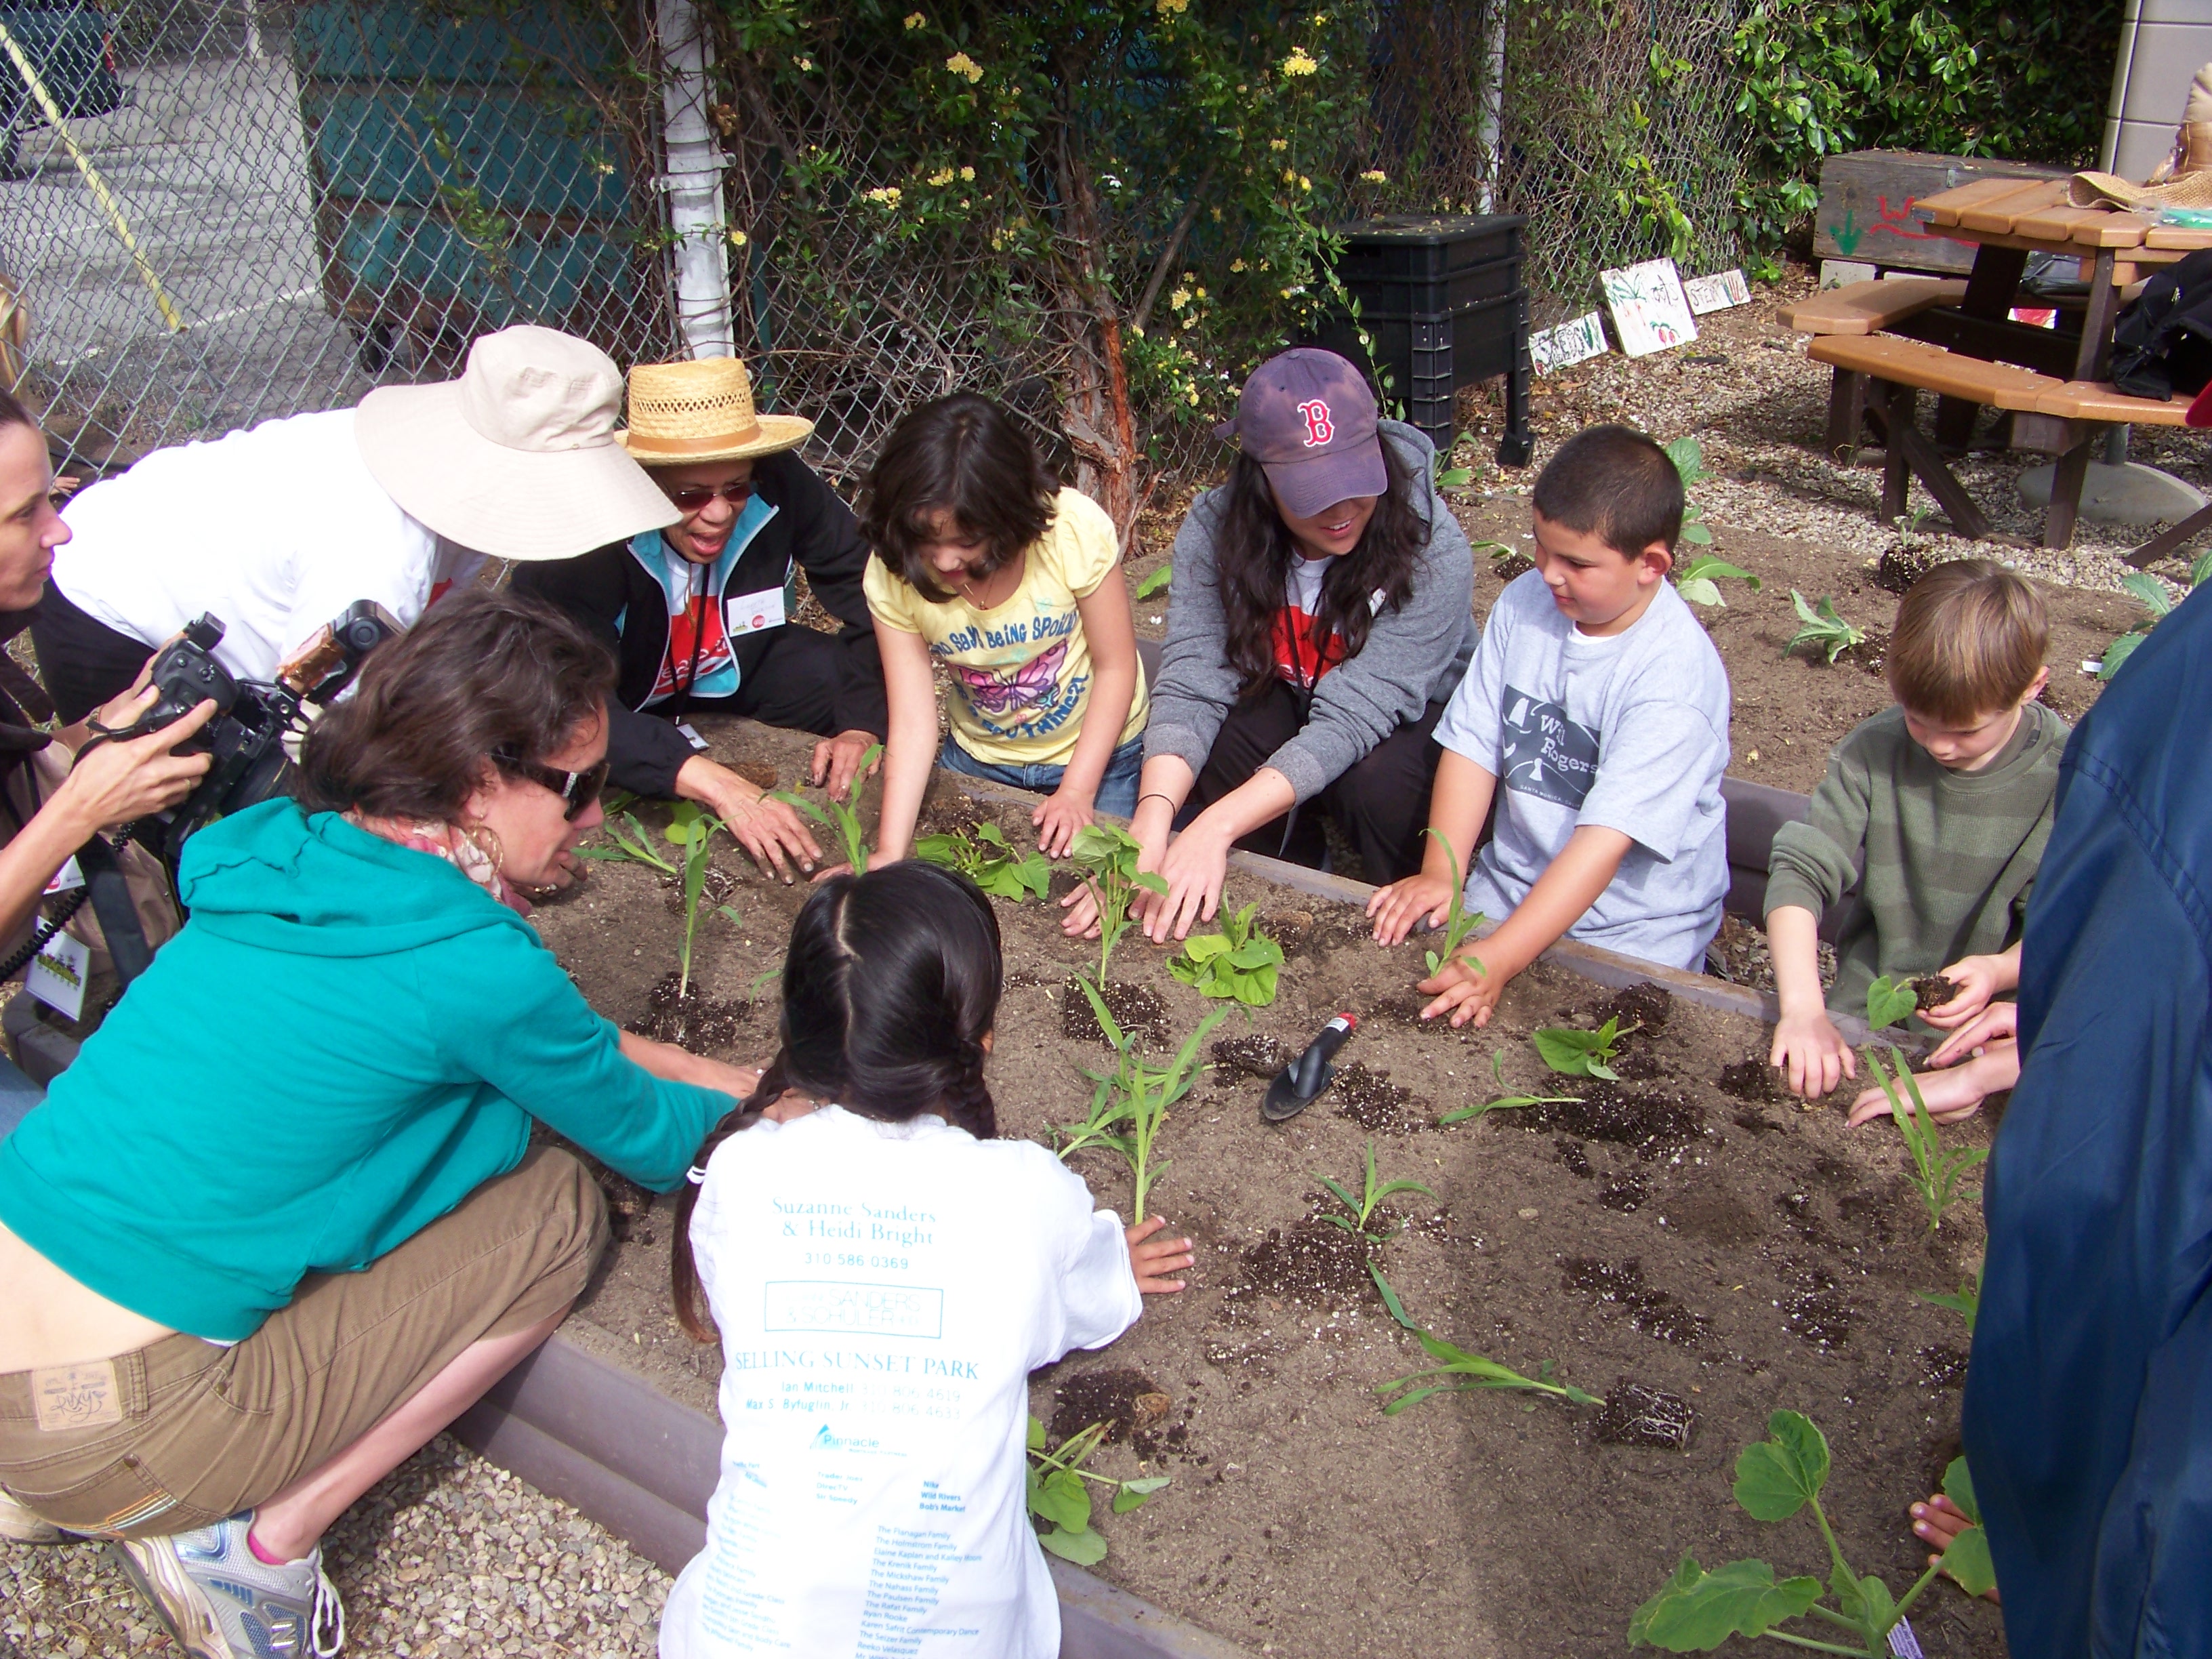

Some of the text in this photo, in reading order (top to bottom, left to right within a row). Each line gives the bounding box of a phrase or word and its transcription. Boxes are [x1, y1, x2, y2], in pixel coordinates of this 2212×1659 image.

[1297, 398, 1335, 447] B
[1540, 737, 1598, 774] Rogers
[1519, 784, 1538, 794] SANTA
[773, 1197, 936, 1223] Suzanne Sanders
[783, 1220, 933, 1248] & Heidi Bright
[805, 1252, 909, 1269] 310 586 0369
[829, 1288, 921, 1312] SANDERS
[800, 1306, 895, 1327] SCHULER
[735, 1350, 979, 1380] SELLING SUNSET PARK
[781, 1381, 798, 1393] Ian
[804, 1381, 854, 1394] Mitchell
[893, 1385, 920, 1399] 806
[926, 1388, 961, 1402] 4619
[745, 1399, 763, 1410] Max
[893, 1403, 919, 1416] 806
[824, 1435, 880, 1448] Pinnacle
[817, 1471, 842, 1479] Trader
[923, 1480, 939, 1489] Nike
[829, 1494, 858, 1506] Speedy
[921, 1491, 961, 1501] Wild Rivers
[919, 1502, 966, 1513] Bob's Market
[878, 1525, 951, 1541] The Flanagan Family
[877, 1536, 958, 1551] The Holmstrom Family
[898, 1550, 923, 1560] Kaplan
[873, 1558, 937, 1573] The Krenik Family
[872, 1569, 884, 1578] The
[926, 1575, 949, 1585] Family
[869, 1579, 939, 1595] The Nahass Family
[868, 1590, 939, 1606] The Paulsen Family
[865, 1600, 880, 1609] The
[903, 1605, 927, 1615] Family
[863, 1610, 907, 1622] Ryan Rooke
[861, 1620, 883, 1629] Karen
[907, 1626, 957, 1637] Contemporary
[959, 1628, 980, 1636] Dance
[754, 1634, 773, 1647] Body
[775, 1637, 792, 1649] Care
[859, 1630, 874, 1639] The
[899, 1636, 922, 1646] Family
[882, 1645, 919, 1656] Velasquez
